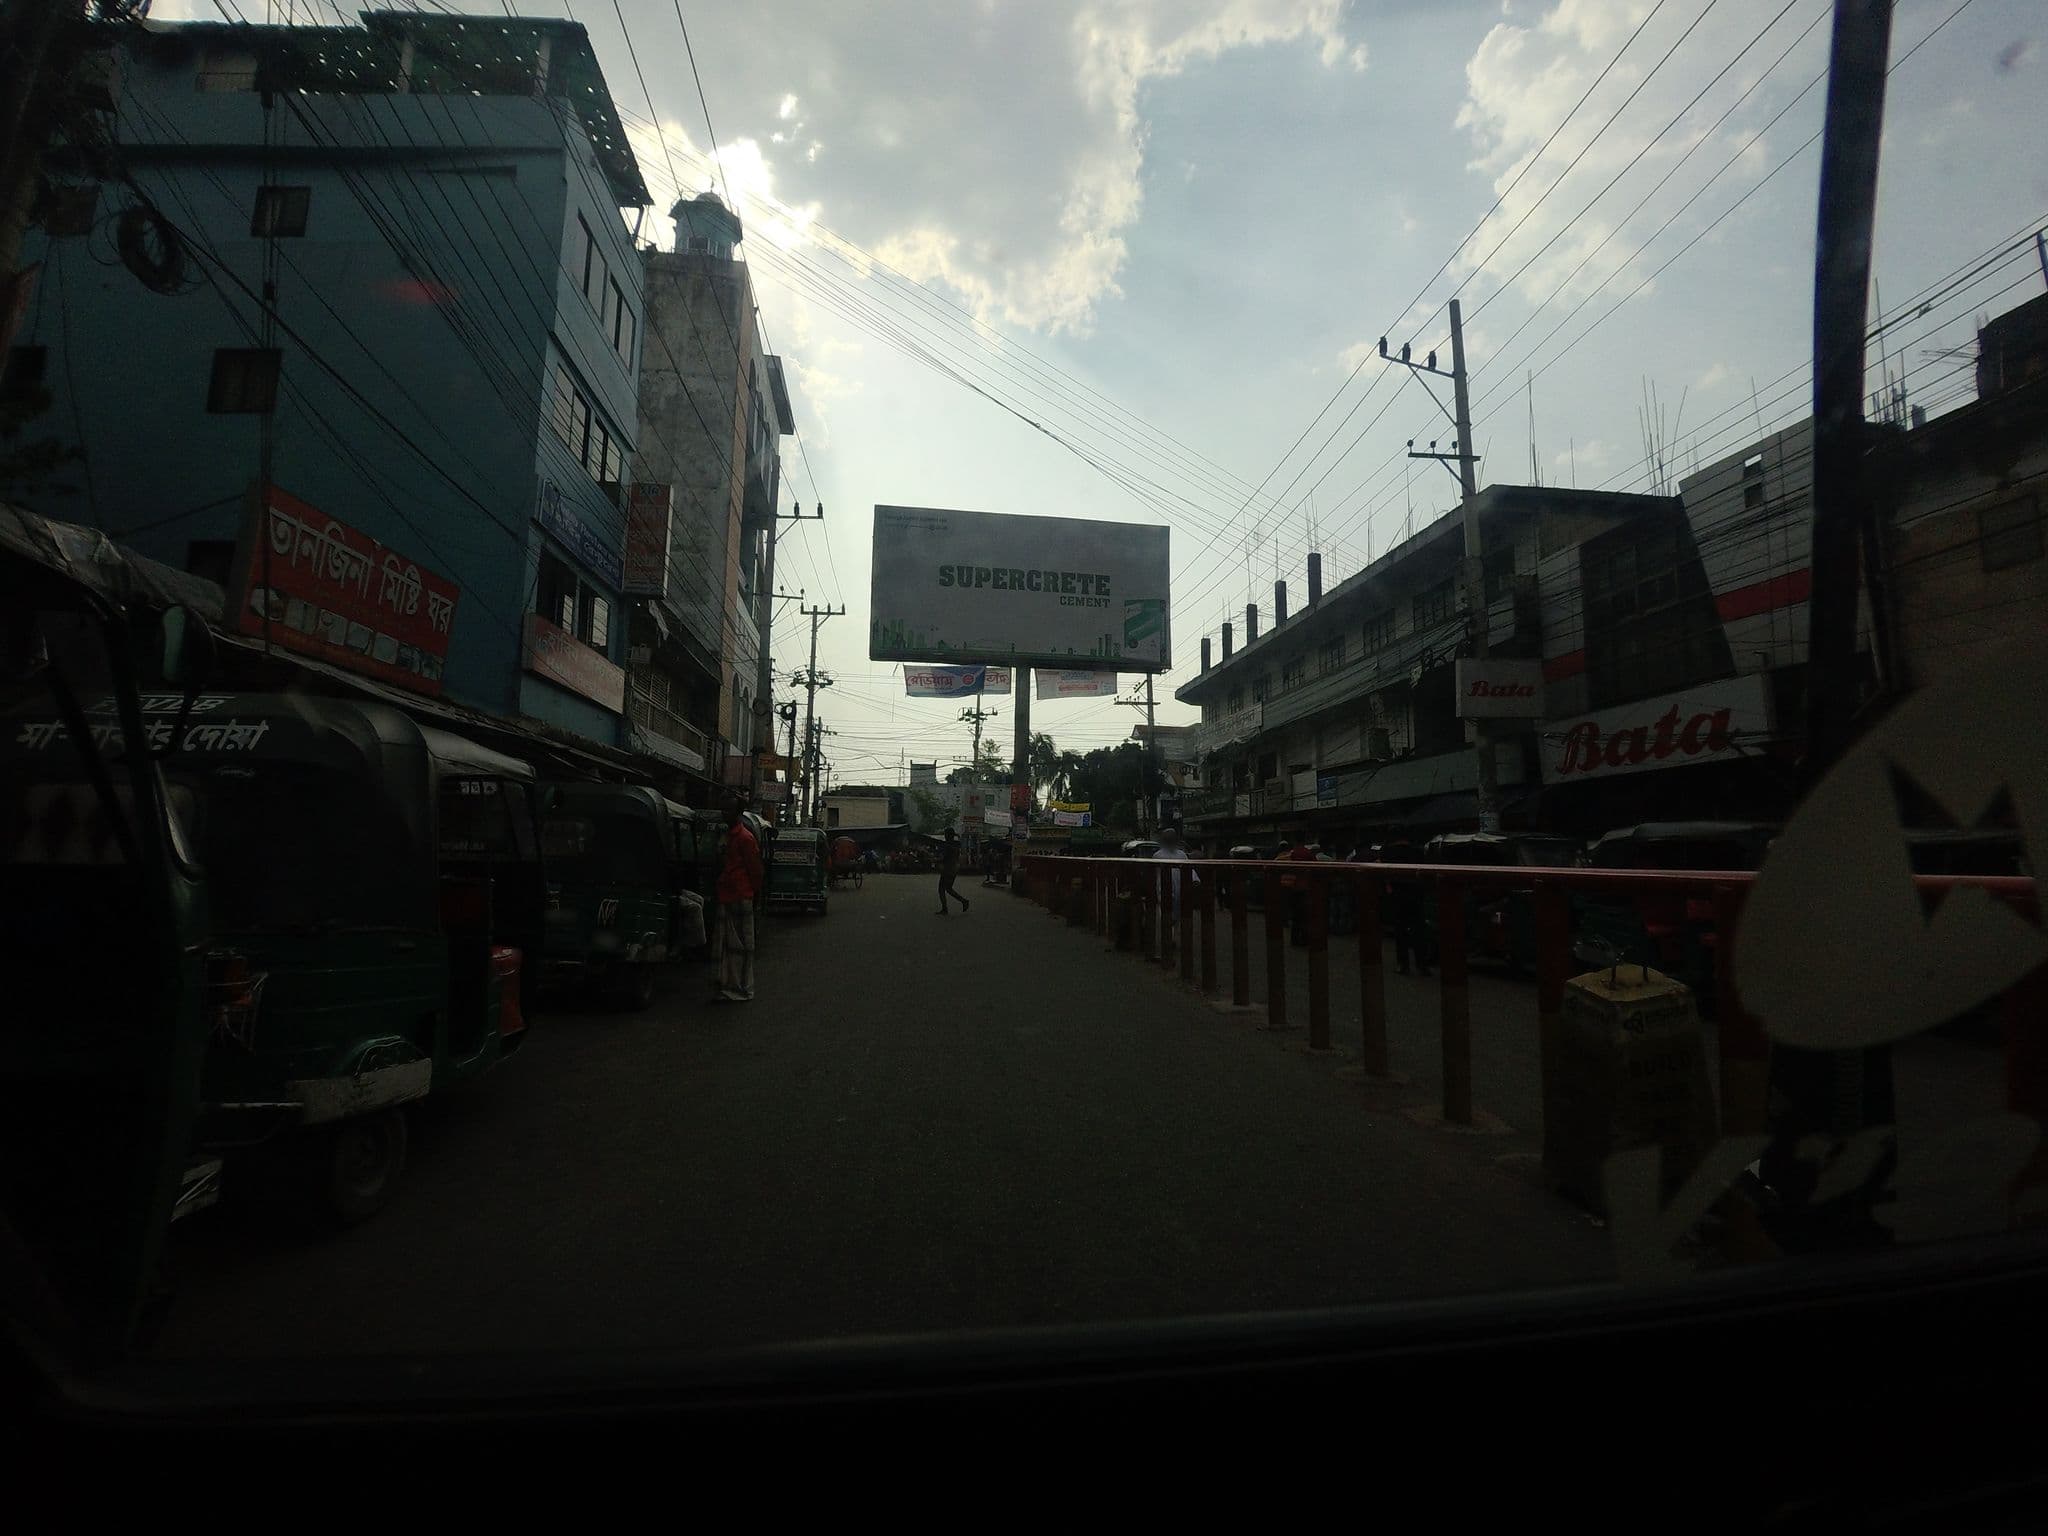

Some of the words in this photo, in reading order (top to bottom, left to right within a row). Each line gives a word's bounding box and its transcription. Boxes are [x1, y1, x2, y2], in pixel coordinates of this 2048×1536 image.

[939, 565, 1110, 597] SUPERCRETE
[427, 588, 456, 635] ঘর
[1059, 596, 1110, 609] CEMENT
[1467, 680, 1537, 698] Bata
[1555, 703, 1733, 779] Bata
